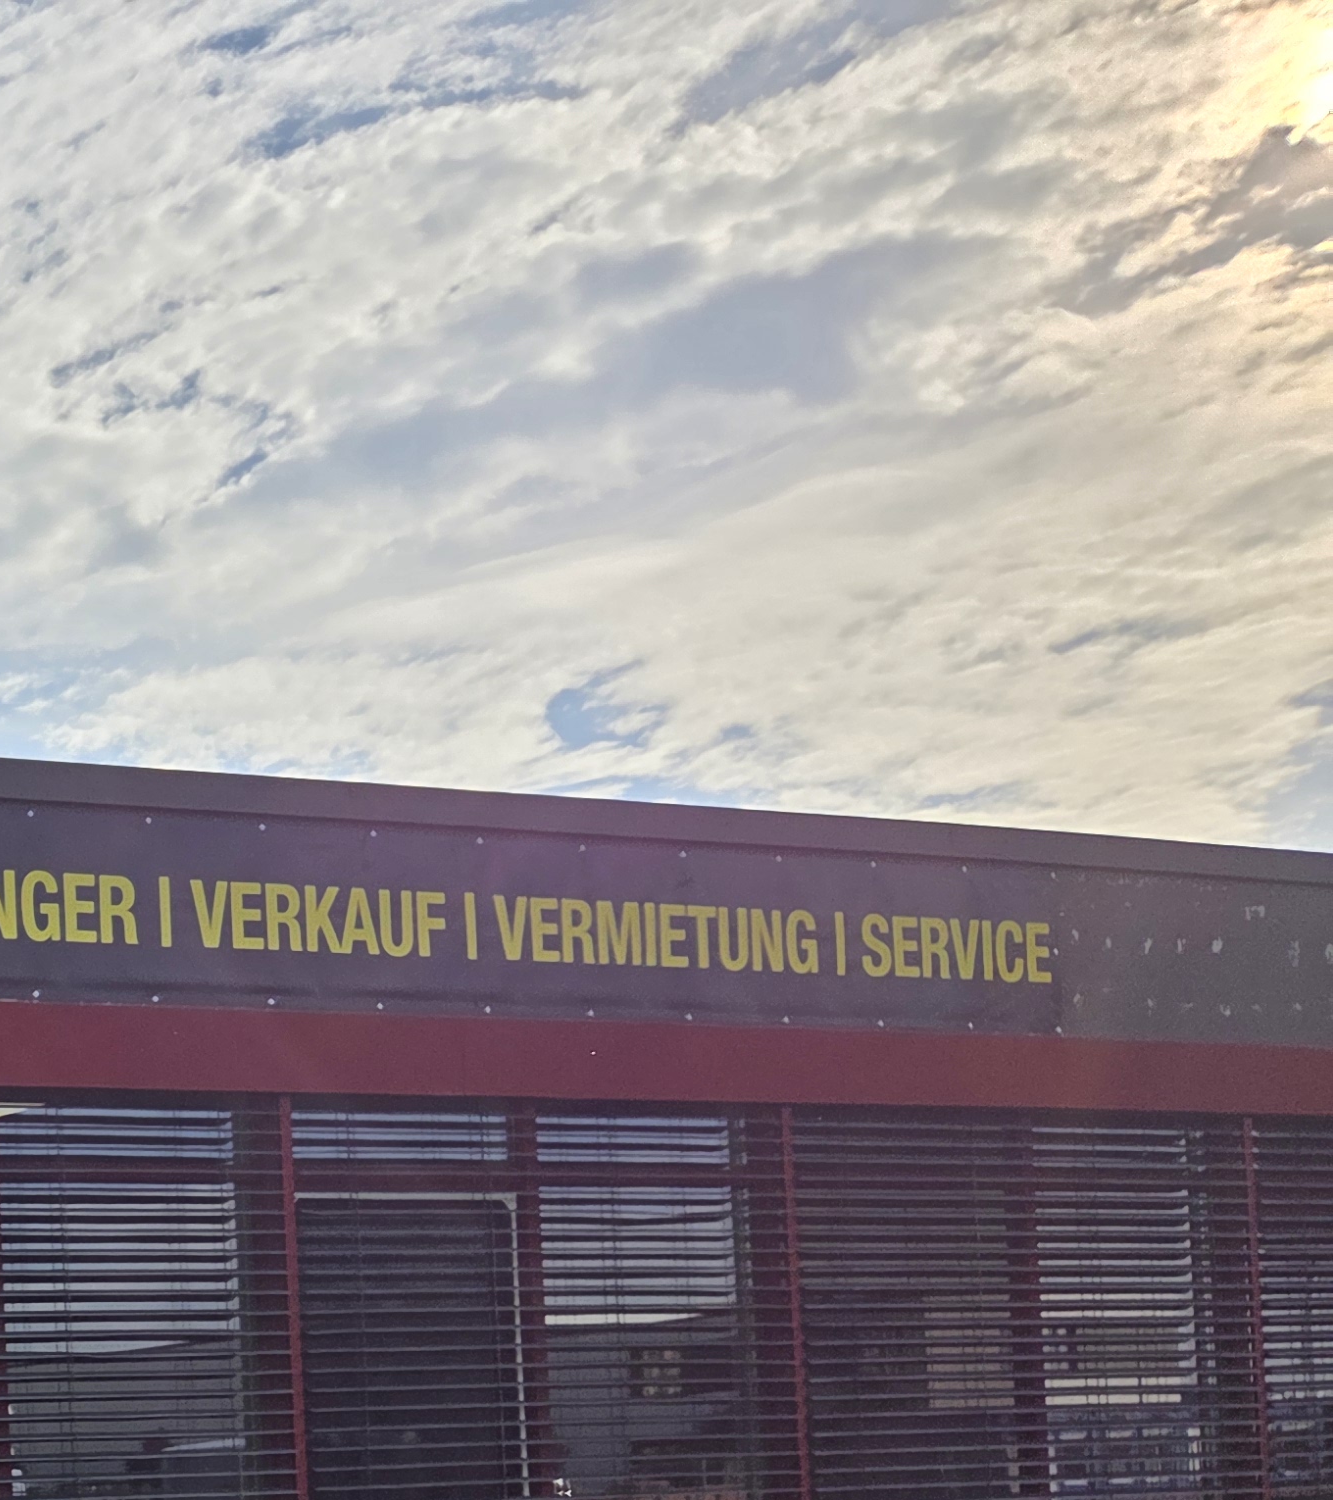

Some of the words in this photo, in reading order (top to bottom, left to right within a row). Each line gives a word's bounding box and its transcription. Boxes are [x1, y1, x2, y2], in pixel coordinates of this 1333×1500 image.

[190, 879, 446, 957] VERKAUF
[492, 894, 820, 974] VERMIETUNG
[861, 913, 1053, 984] SERVICE
